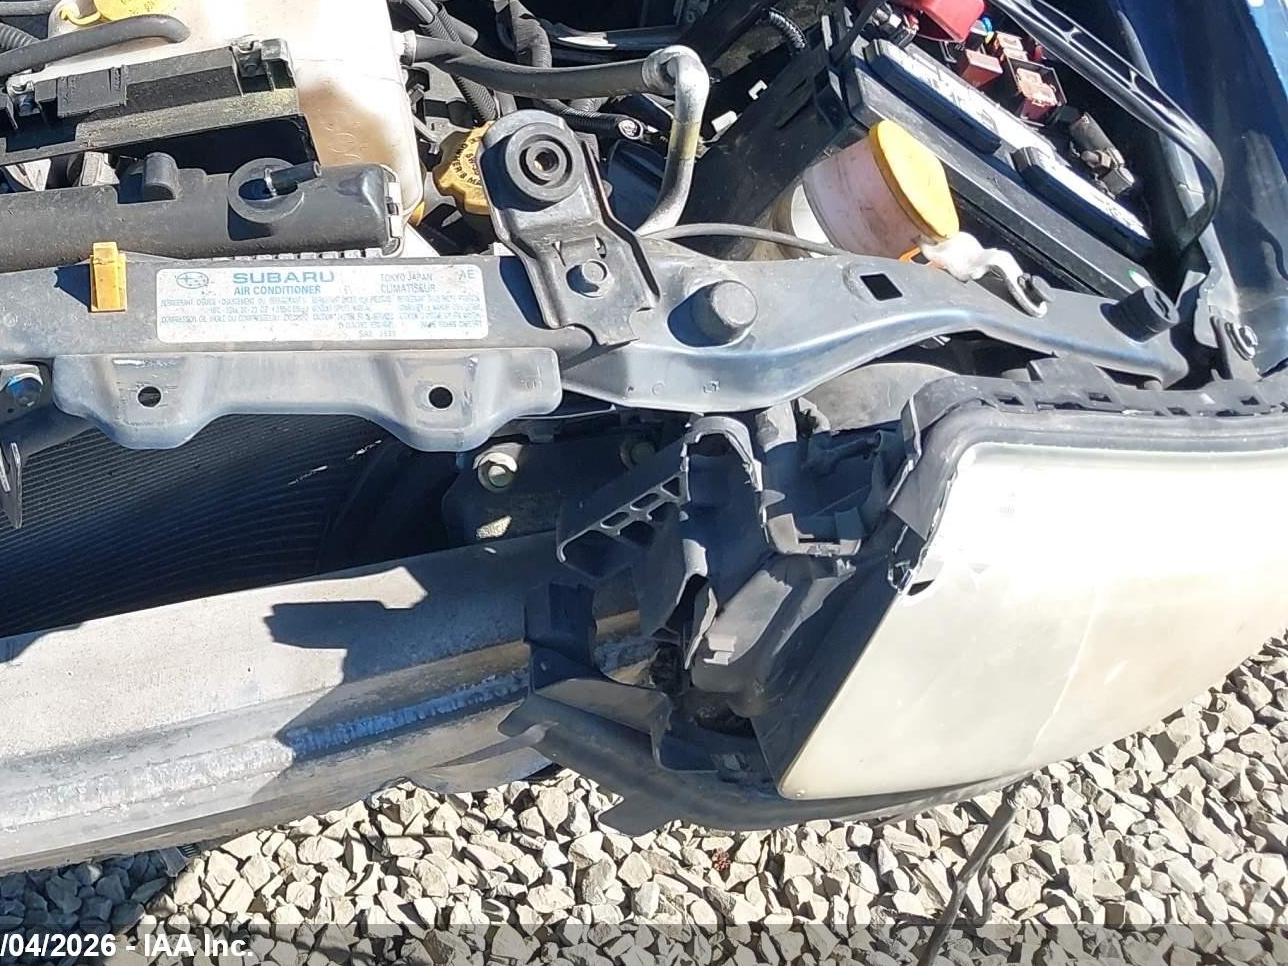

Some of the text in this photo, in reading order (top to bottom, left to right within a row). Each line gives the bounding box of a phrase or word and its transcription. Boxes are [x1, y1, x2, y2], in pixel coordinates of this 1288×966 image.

[233, 271, 334, 284] SUBARU
[380, 273, 406, 282] TOKYO
[408, 273, 433, 282] JAPAN
[234, 286, 250, 295] AIR
[253, 285, 321, 295] CONDITIONER
